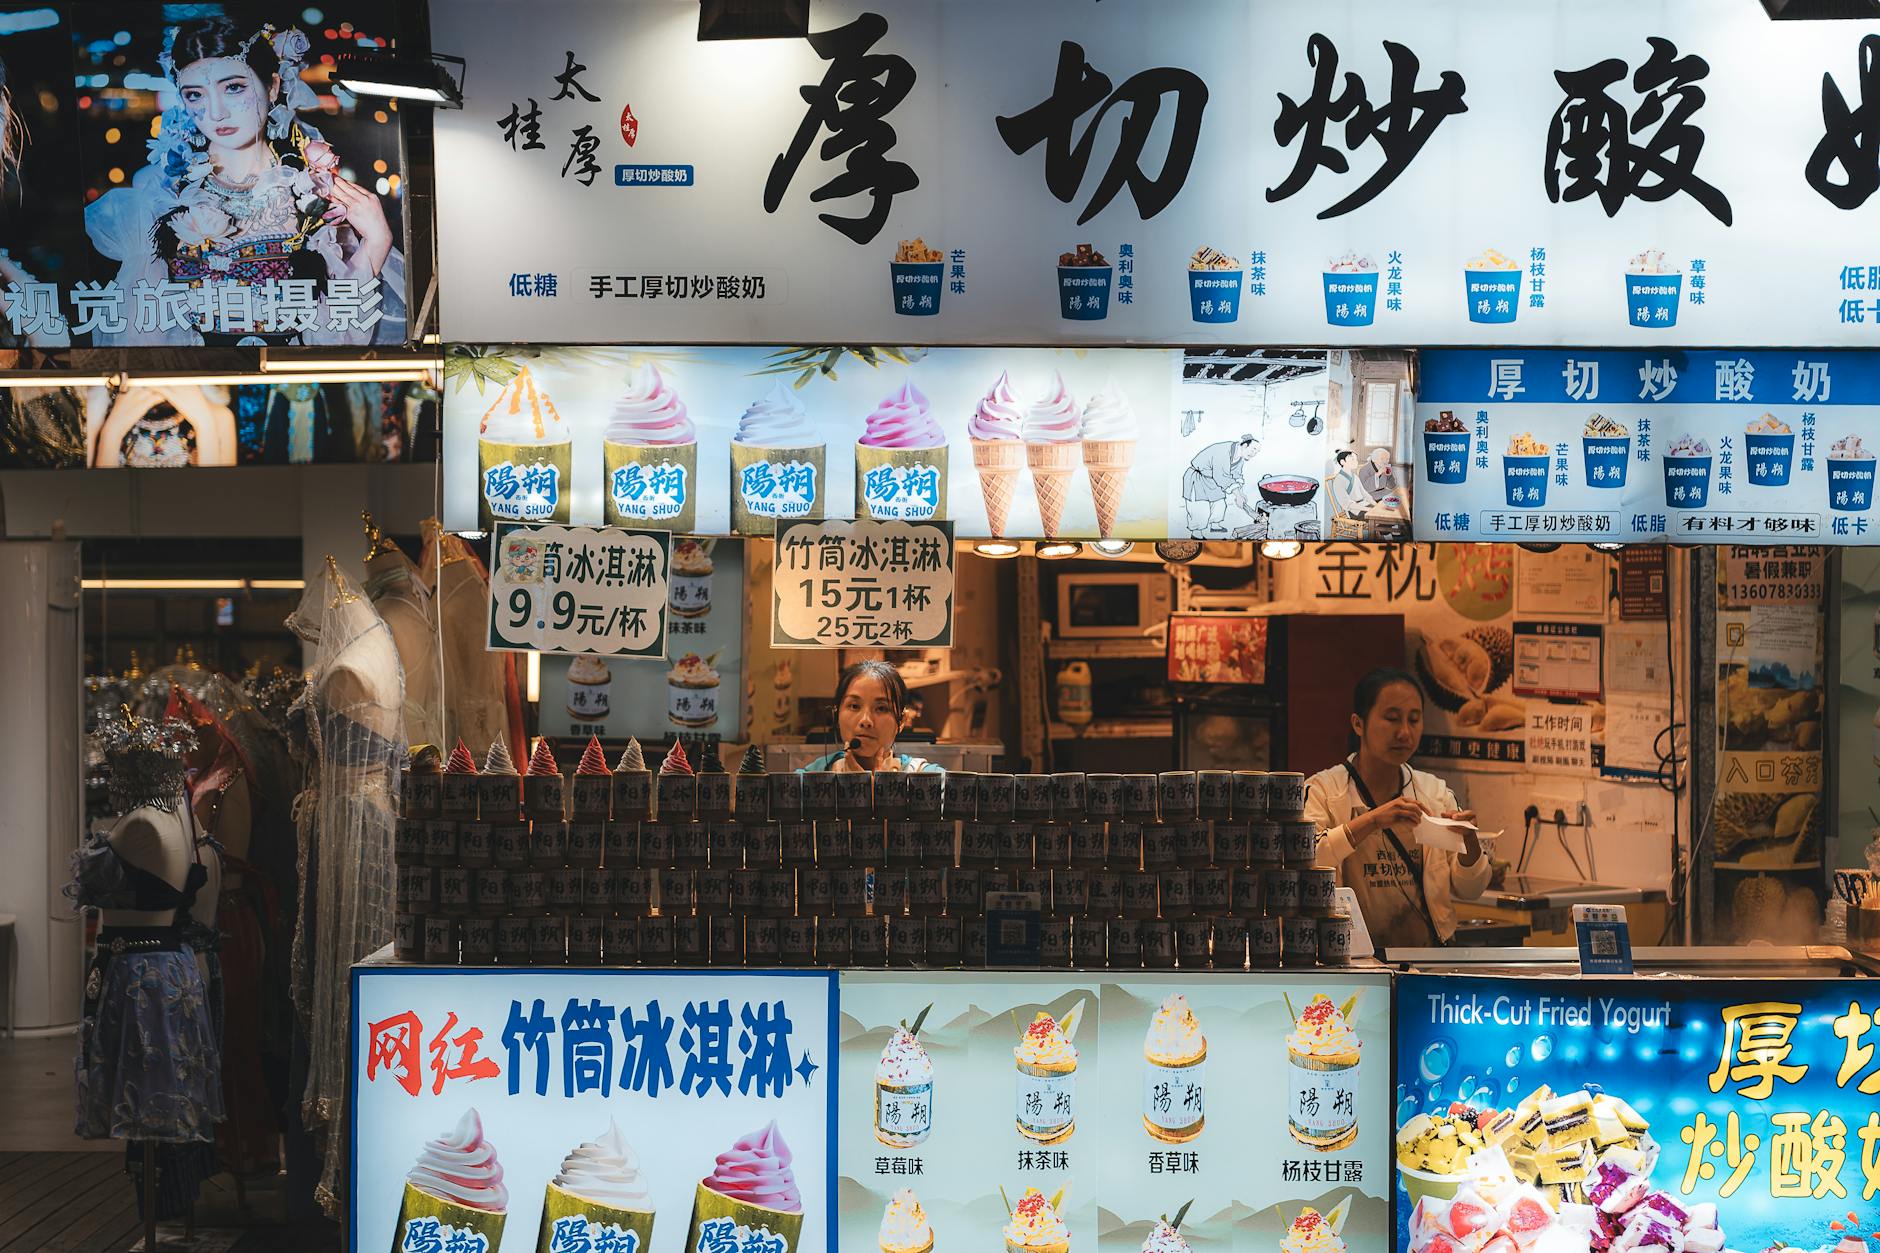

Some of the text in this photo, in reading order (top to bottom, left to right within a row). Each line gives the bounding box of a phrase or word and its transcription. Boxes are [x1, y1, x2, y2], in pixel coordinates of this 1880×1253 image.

[622, 168, 687, 183] 厚切炒酸奶
[950, 249, 966, 295] 芒果味
[1118, 243, 1134, 305] 奥利奥味
[1251, 250, 1267, 296] 抹茶味
[1387, 250, 1402, 311] 火龙果味
[1529, 247, 1546, 308] 杨枝甘露
[1689, 259, 1706, 305] 草莓味
[509, 273, 557, 298] 低糖
[588, 275, 766, 300] 手工厚切炒酸奶
[3, 278, 383, 335] 视觉旅拍摄影
[901, 294, 932, 310] 陽朔
[1069, 295, 1101, 311] 陽朔
[1200, 299, 1232, 315] 陽朔
[1336, 303, 1368, 319] 陽朔
[1477, 299, 1510, 315] 陽朔
[1636, 306, 1669, 322] 陽朔
[1487, 358, 1832, 402] 厚切炒酸奶
[1475, 410, 1489, 469] 奥利奥味
[1637, 418, 1651, 462] 抹茶味
[1801, 412, 1816, 472] 杨枝甘露
[1433, 459, 1461, 474] 陽朔
[1555, 443, 1569, 487] 芒果味
[1593, 465, 1621, 481] 陽朔
[1718, 436, 1732, 495] 火龙果味
[1755, 461, 1784, 477] 陽朔
[485, 465, 558, 505] 陽朔
[613, 465, 684, 505] 陽朔
[742, 463, 814, 503] 陽朔
[866, 466, 938, 507] 陽朔
[1512, 487, 1540, 502] 陽朔
[1674, 485, 1702, 501] 陽朔
[491, 502, 553, 515] YANG SHUO
[618, 502, 680, 515] YANG SHUO
[748, 500, 810, 514] YANG SHUO
[1836, 490, 1865, 505] 陽朔
[870, 504, 933, 517] YANG SHUO
[1435, 512, 1470, 531] 低糖
[1490, 514, 1611, 532] 手工厚切炒酸奶
[1631, 514, 1666, 533] 低脂
[1682, 516, 1816, 533] 有料才够味
[1832, 516, 1868, 535] 低卡
[543, 541, 657, 588] 筒冰淇淋
[786, 534, 941, 573] 竹筒冰淇淋
[1744, 561, 1812, 580] 暑假兼职
[800, 578, 931, 611] 15元1杯
[817, 616, 913, 640] 25元2杯
[1532, 714, 1583, 732] 工作时间
[1427, 993, 1672, 1034] Thick-Cut Fried Yogurt
[366, 1010, 502, 1098] 网红
[500, 999, 793, 1099] 竹筒冰淇淋
[1026, 1091, 1070, 1116] 陽朔
[1153, 1082, 1202, 1113] 陽朔
[1300, 1087, 1353, 1117] 陽朔
[885, 1101, 927, 1125] 陽朔
[875, 1157, 923, 1175] 草莓味
[1018, 1150, 1069, 1170] 抹茶味
[1149, 1151, 1200, 1174] 香草味
[1282, 1159, 1363, 1182] 杨枝甘露
